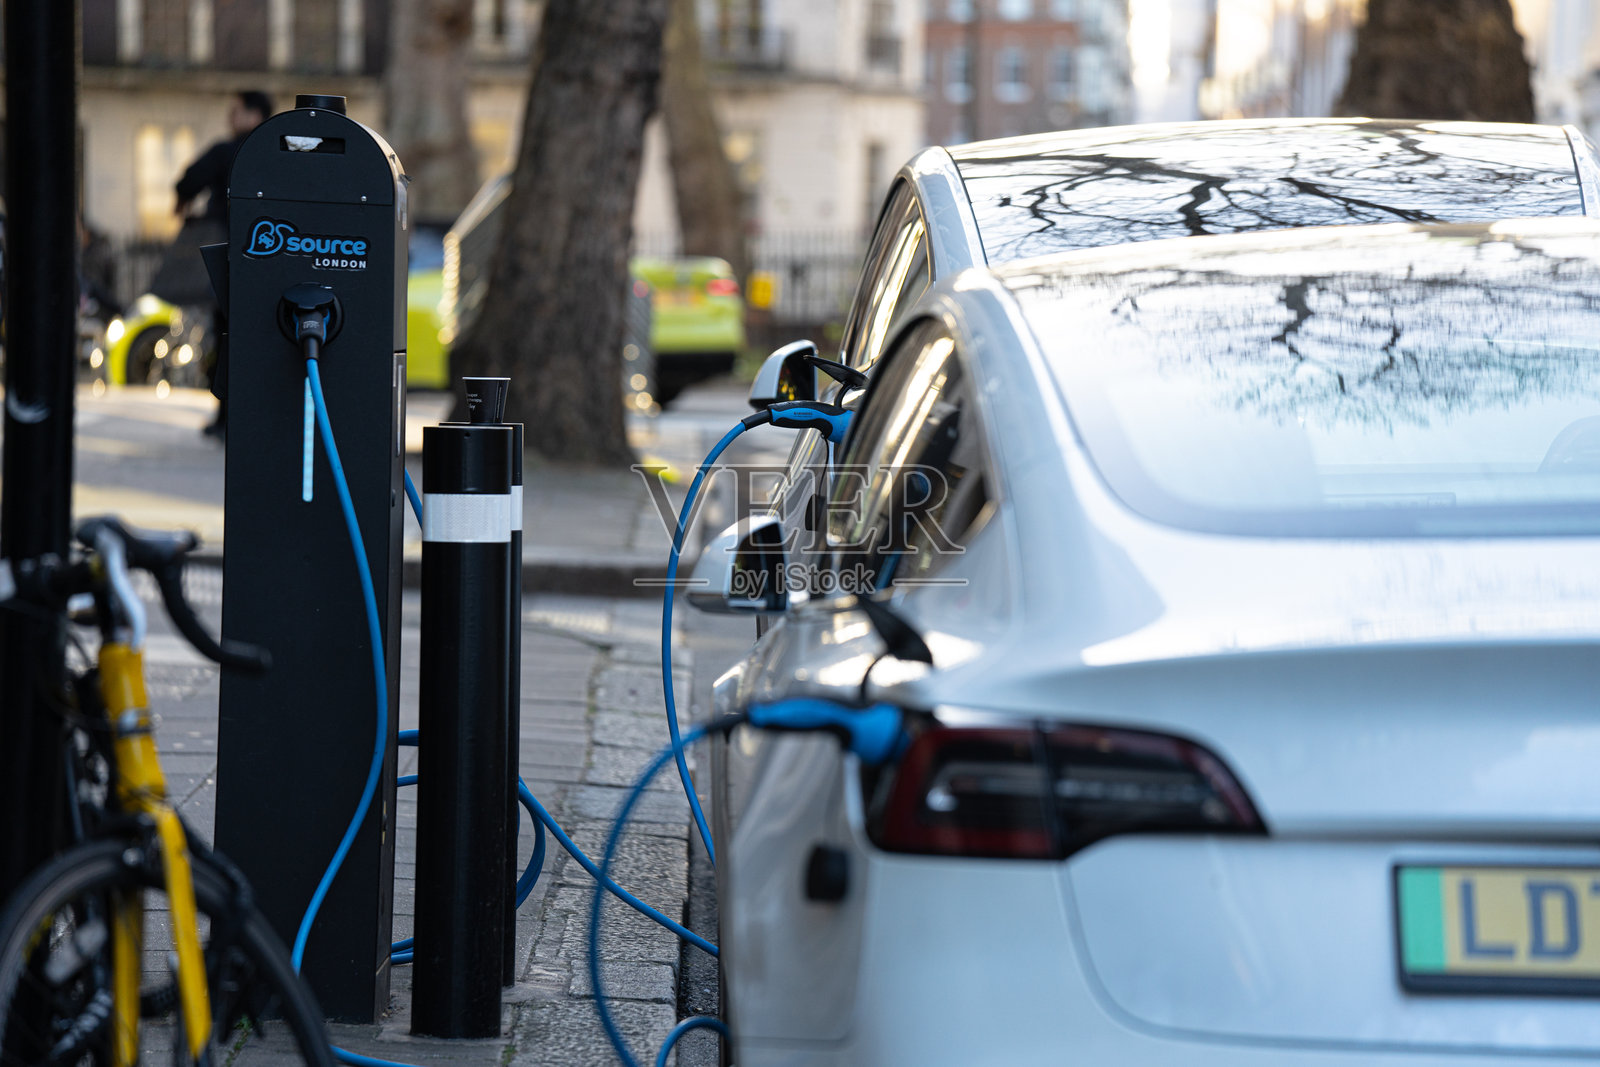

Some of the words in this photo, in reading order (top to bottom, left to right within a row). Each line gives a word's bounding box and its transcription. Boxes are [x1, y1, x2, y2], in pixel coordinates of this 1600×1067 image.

[286, 236, 367, 256] source
[315, 258, 367, 269] LONDON
[1458, 879, 1600, 960] LD
